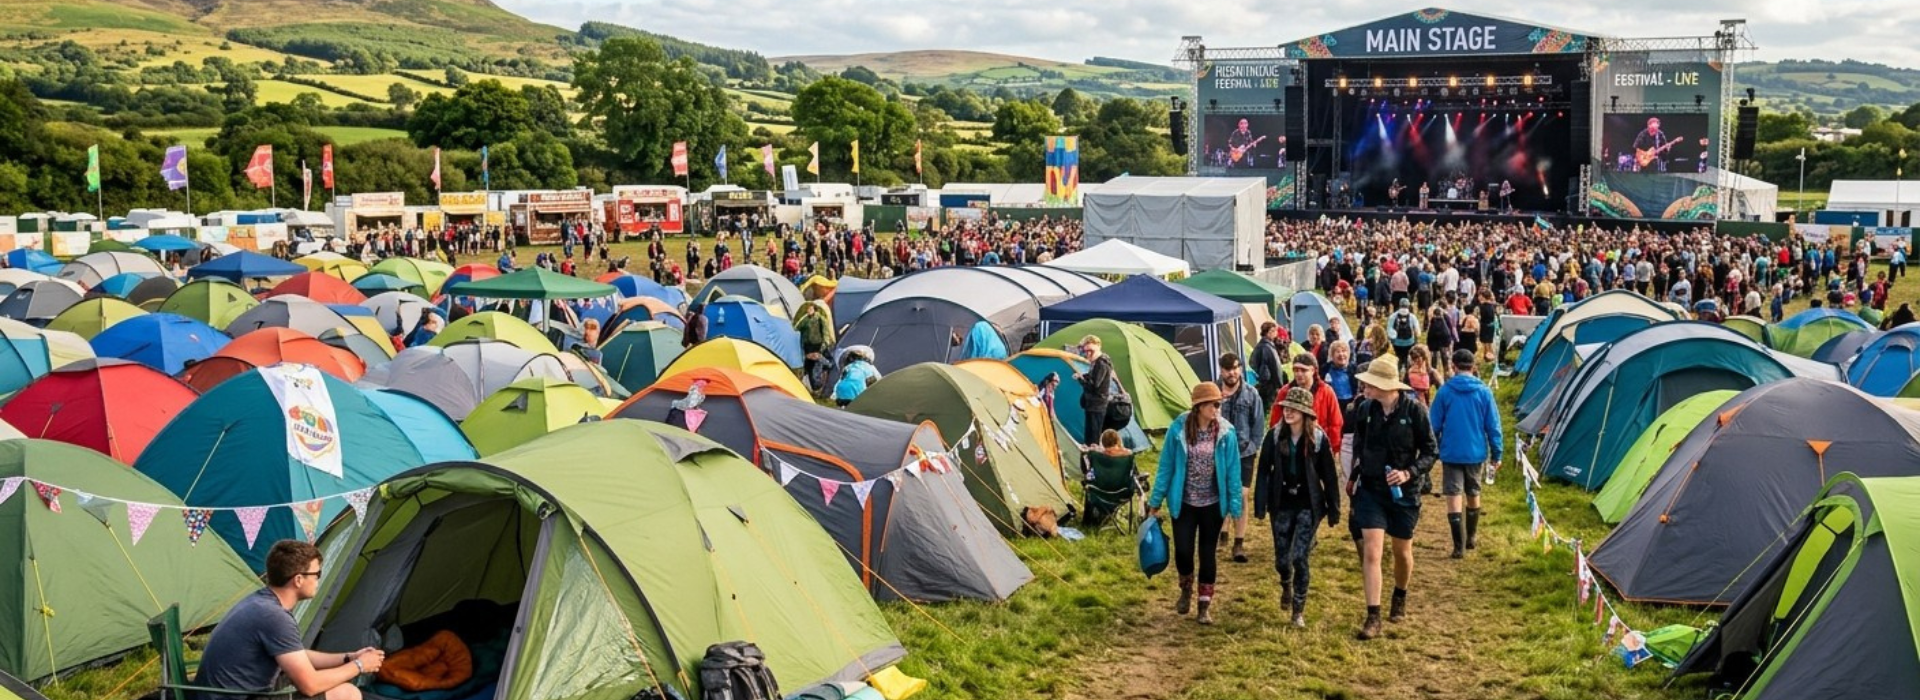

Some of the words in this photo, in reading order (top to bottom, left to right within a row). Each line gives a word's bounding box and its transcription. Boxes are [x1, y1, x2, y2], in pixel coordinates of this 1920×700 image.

[1366, 28, 1421, 53] MAIN
[1428, 26, 1497, 51] STAGE
[1674, 72, 1699, 86] LIVE
